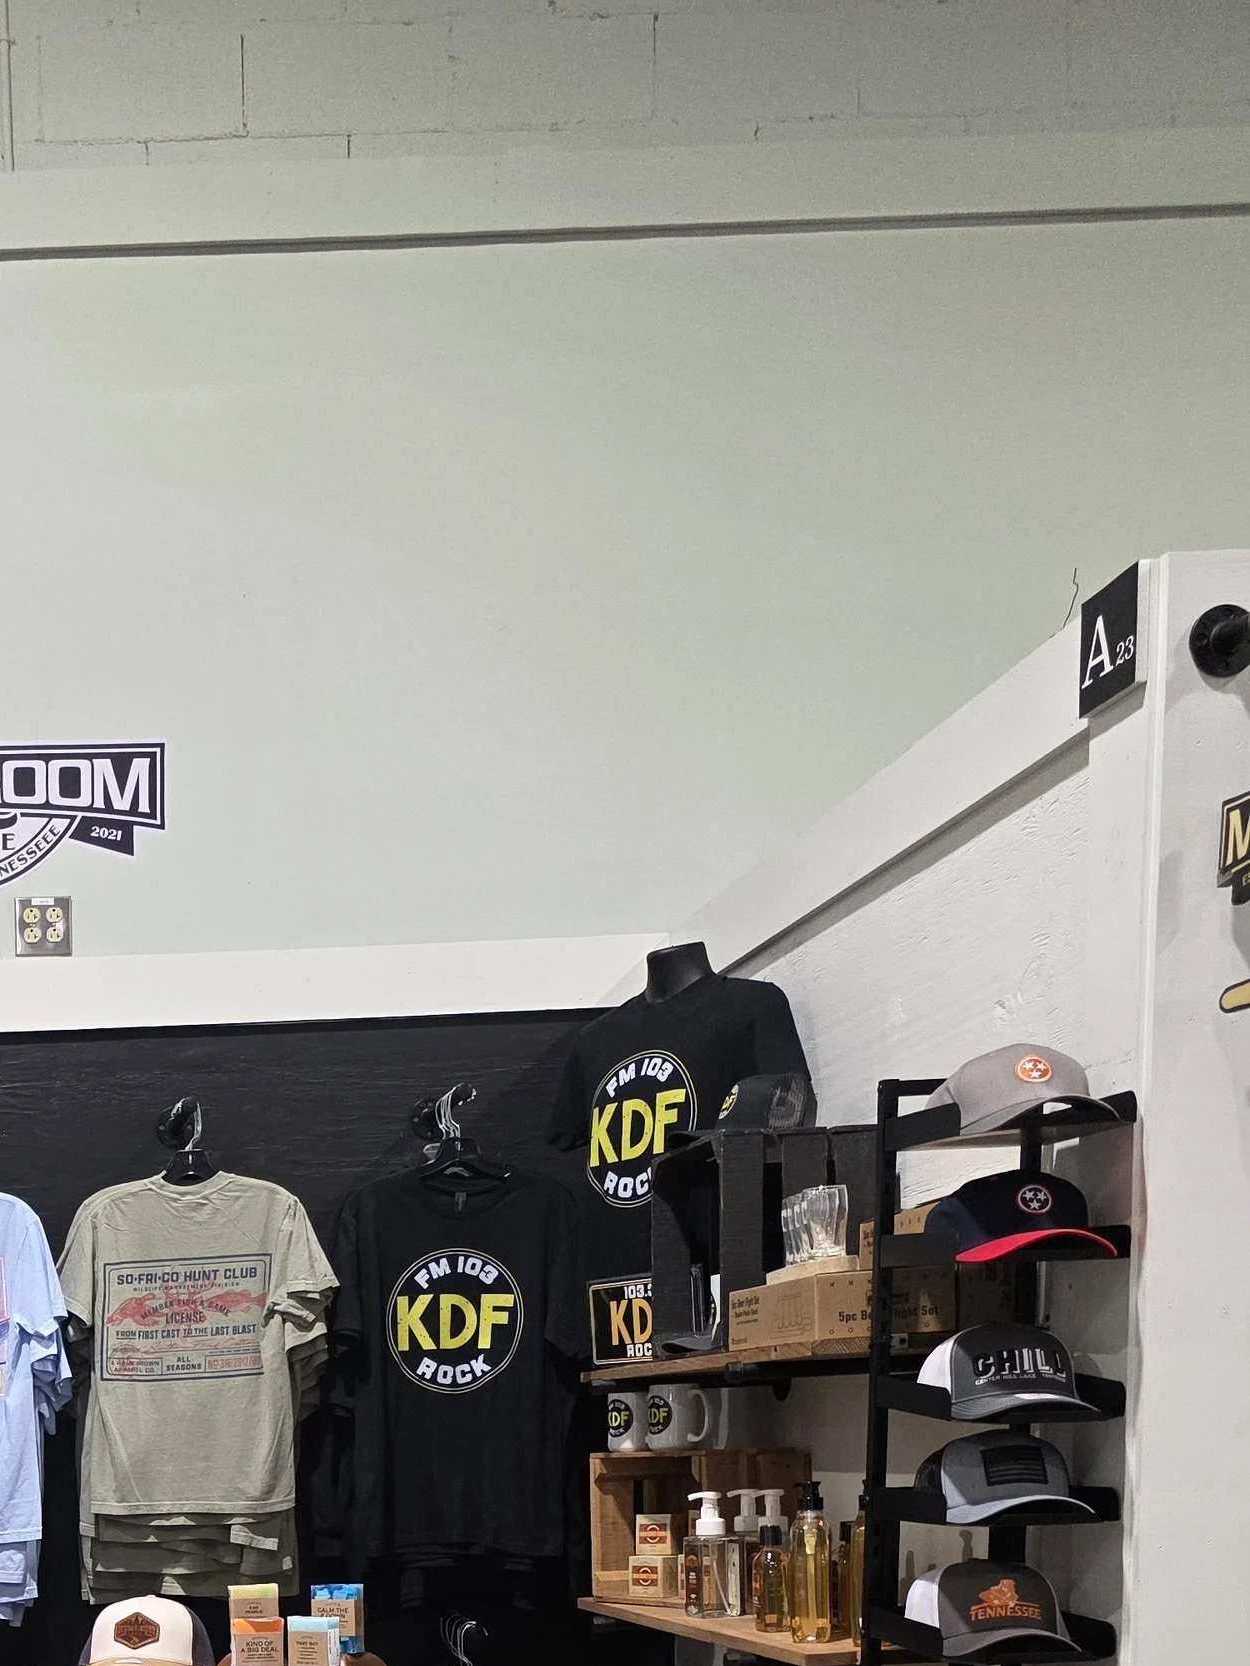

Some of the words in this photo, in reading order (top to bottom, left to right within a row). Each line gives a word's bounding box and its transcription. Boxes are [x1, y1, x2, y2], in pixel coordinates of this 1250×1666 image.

[90, 826, 123, 841] 2021
[605, 1062, 636, 1097] FM
[640, 1057, 674, 1082] 103
[589, 1088, 687, 1168] KDF
[603, 1167, 652, 1198] ROC
[183, 1269, 220, 1282] HUNT
[223, 1267, 258, 1279] CLUB
[414, 1257, 452, 1290] FM
[457, 1256, 499, 1285] 103
[165, 1311, 205, 1324] LICENSE
[396, 1293, 515, 1351] KDF
[609, 1299, 653, 1346] KD
[838, 1310, 857, 1323] 5pc
[116, 1330, 137, 1338] FROM
[137, 1330, 159, 1340] FIRST
[161, 1329, 180, 1339] CAST
[210, 1325, 229, 1336] LAST
[232, 1324, 256, 1335] BLAST
[627, 1344, 653, 1358] ROC
[166, 1363, 202, 1372] SEASONS
[415, 1353, 492, 1385] ROCK
[973, 1347, 1067, 1380] CHILL
[649, 1407, 669, 1424] DF
[969, 1604, 1042, 1622] TENNESSEE
